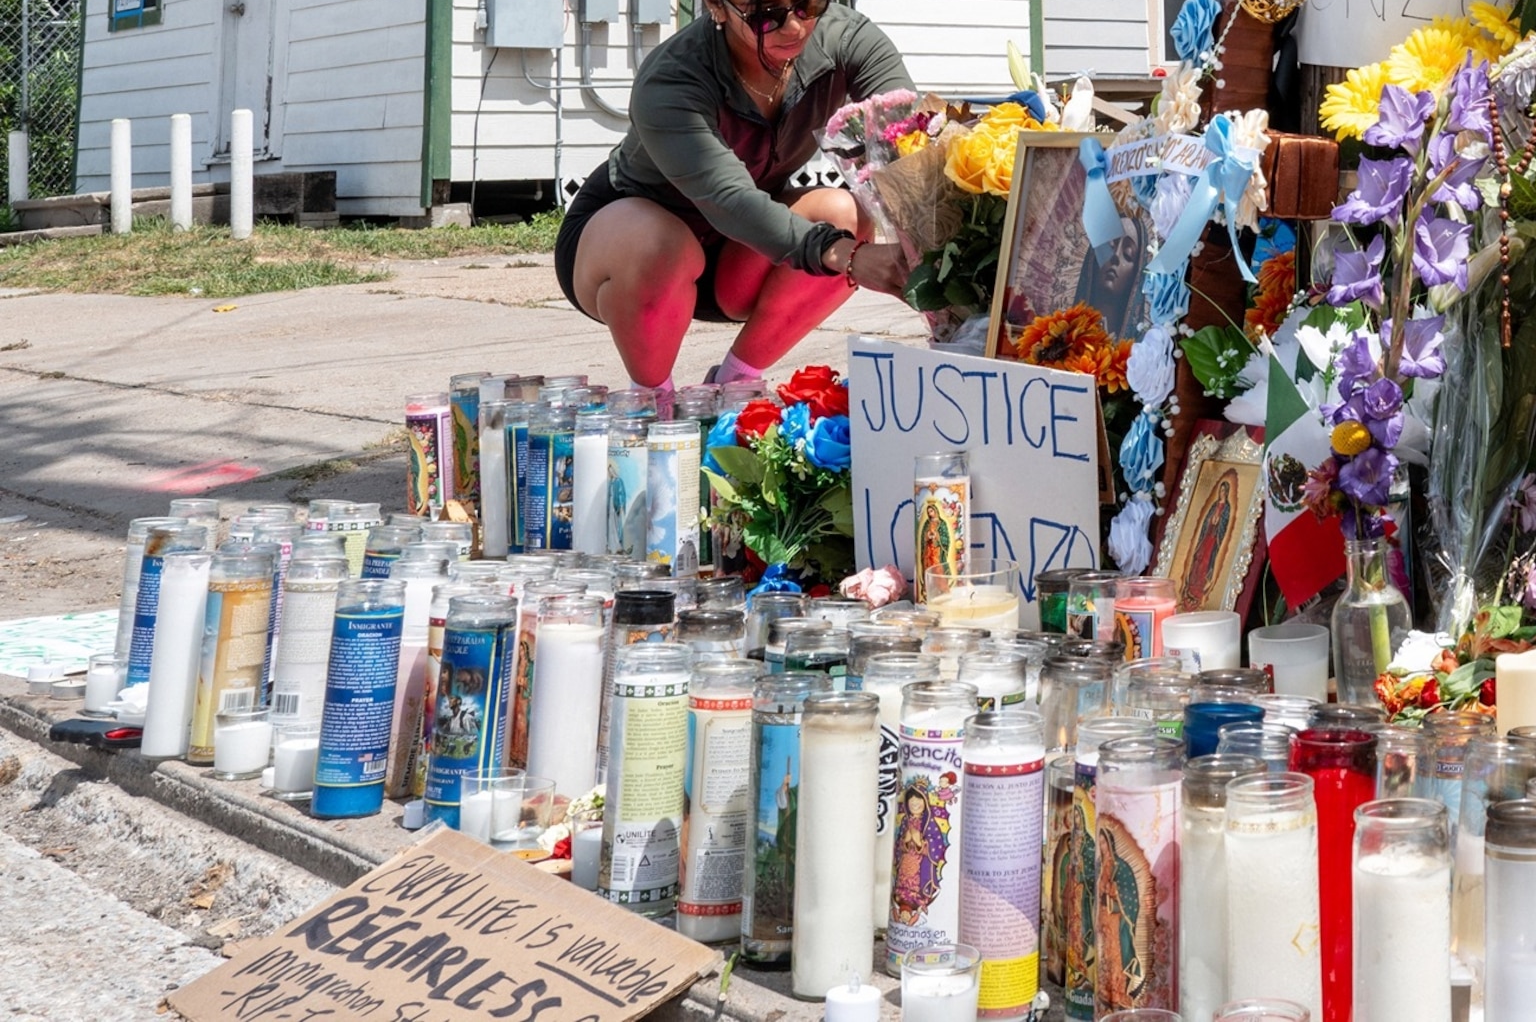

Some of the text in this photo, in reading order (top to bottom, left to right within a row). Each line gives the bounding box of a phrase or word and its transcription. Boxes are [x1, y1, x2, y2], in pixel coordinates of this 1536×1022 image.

[852, 351, 1090, 463] JUSTICE
[625, 830, 657, 839] UNILITE
[437, 883, 538, 935] LIFE
[1069, 989, 1095, 1006] Guadal
